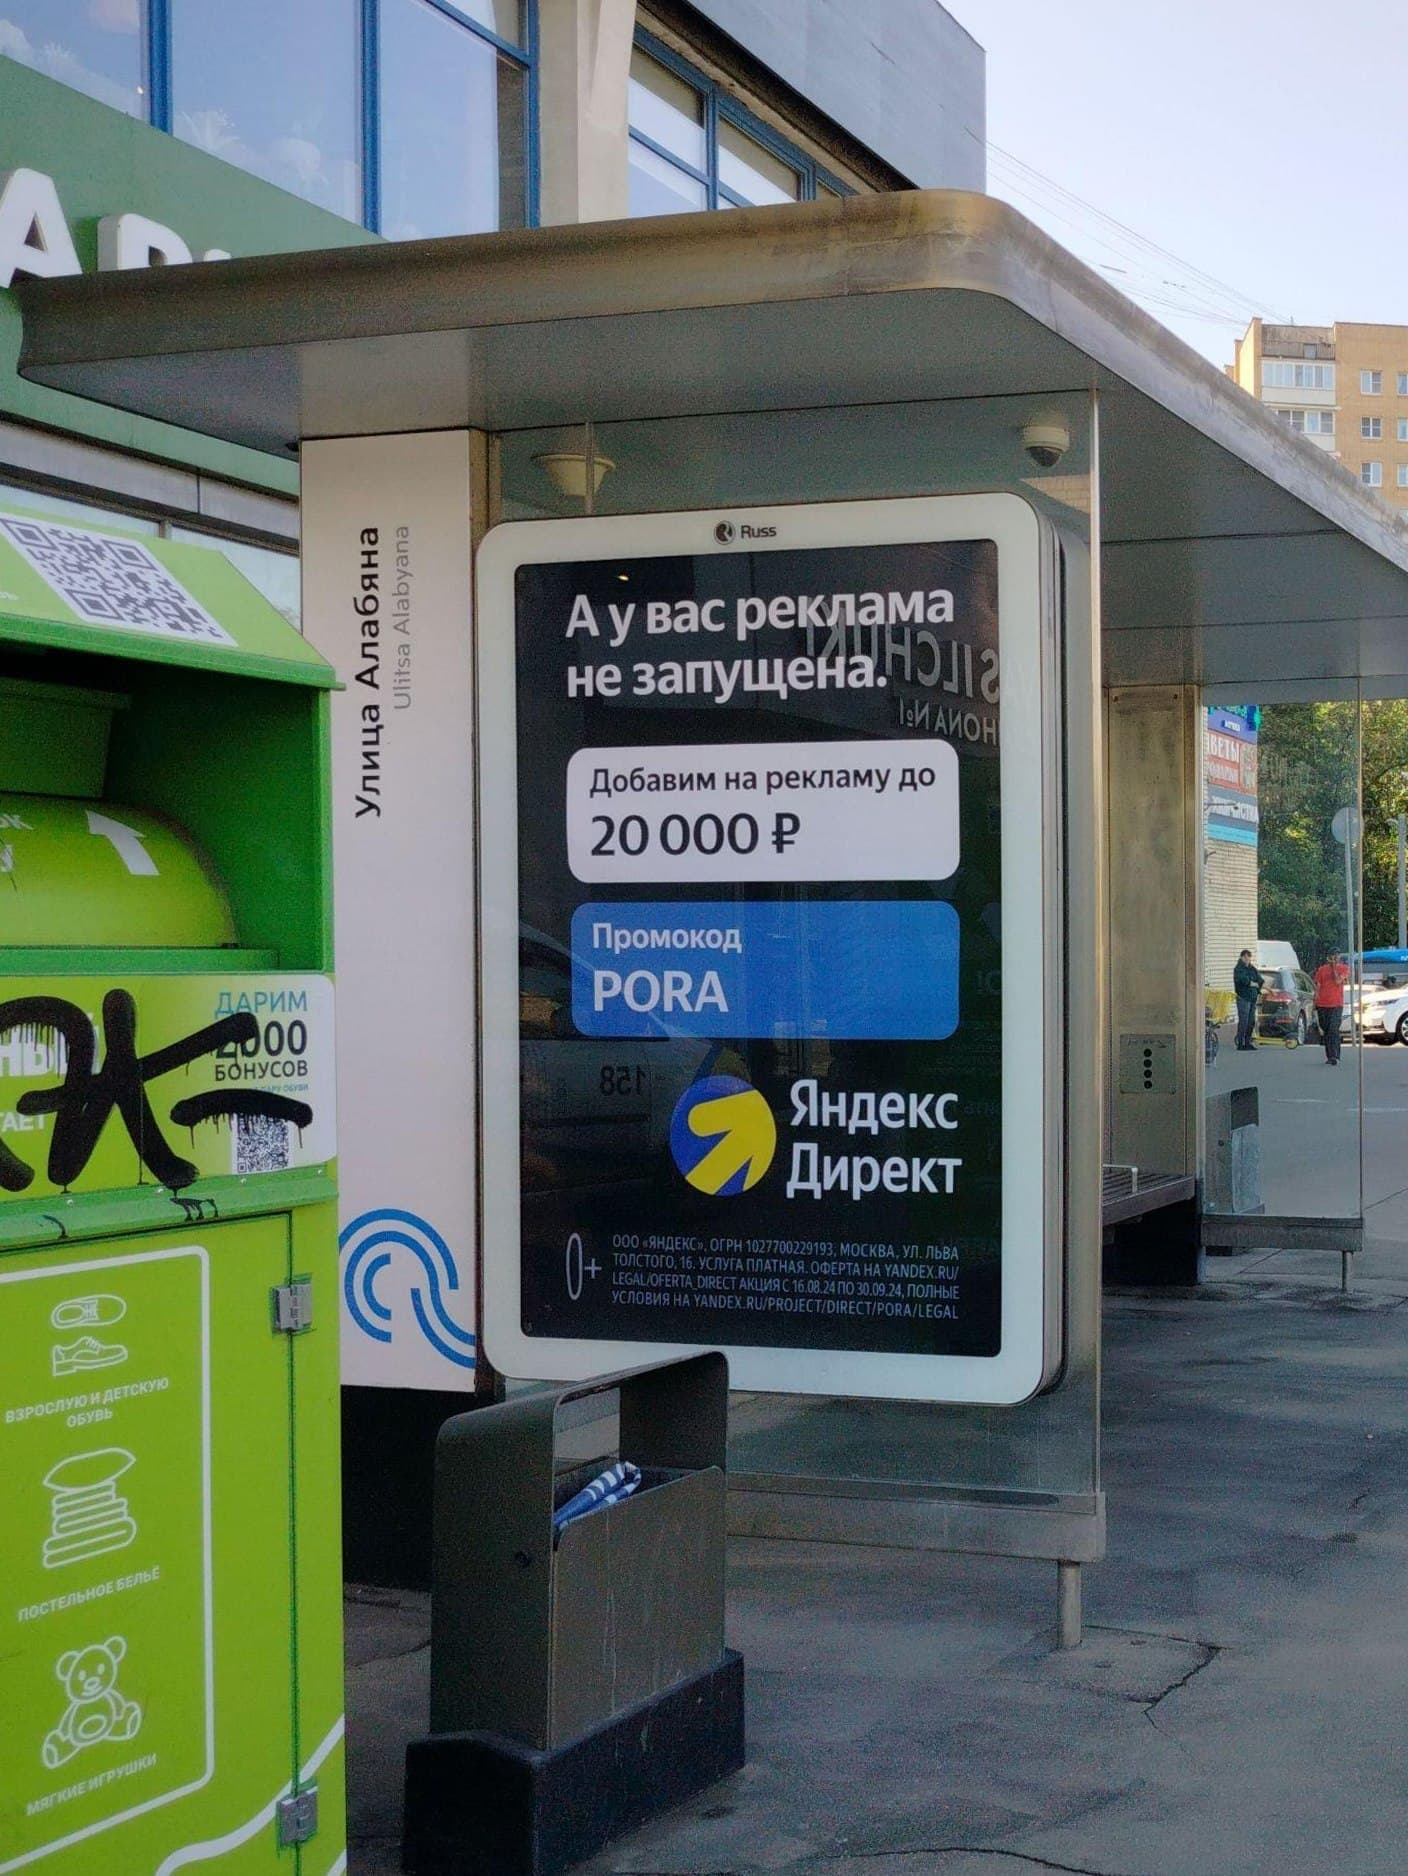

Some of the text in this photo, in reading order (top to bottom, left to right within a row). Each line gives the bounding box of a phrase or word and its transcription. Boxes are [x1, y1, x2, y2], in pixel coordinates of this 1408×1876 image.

[741, 524, 777, 539] Russ
[391, 525, 414, 710] Ulitsa Alabyana
[566, 588, 954, 647] А у вас реклама
[353, 527, 384, 818] Улица Алабяна
[567, 654, 887, 703] не запущена.
[1208, 734, 1240, 763] ВЕТЫ
[590, 766, 935, 797] Добавим на рекламу до
[592, 922, 743, 954] Промокод
[215, 990, 308, 1019] ДАРИМ
[593, 970, 729, 1012] PORA
[215, 1060, 308, 1082] БОНУСОВ
[0, 1112, 46, 1132] АЕТ
[790, 1079, 958, 1135] Яндекс
[786, 1142, 963, 1200] Директ
[612, 1234, 640, 1249] ООО
[710, 1238, 742, 1252] ОГРН
[840, 1243, 900, 1260] МОСКВА,
[903, 1245, 922, 1259] УЛ.
[925, 1245, 959, 1260] ЛЬВА
[613, 1252, 677, 1270] ТОЛСТОГО,
[699, 1256, 743, 1272] УСЛУГА
[746, 1258, 808, 1274] ПЛАТНАЯ.
[811, 1261, 861, 1277] ОФЕРТА
[864, 1263, 881, 1277] НА
[884, 1264, 960, 1280] YANDEX.RU/
[612, 1290, 670, 1305] УСЛОВИЯ
[673, 1292, 691, 1307] НА
[739, 1276, 780, 1293] АКЦИЯ
[838, 1281, 855, 1296] ПО
[907, 1284, 960, 1300] ПОЛНЫЕ
[5, 1377, 169, 1424] ВЗРОСЛУЮ И ДЕТСКУЮ
[66, 1407, 113, 1429] ОБУВЬ
[18, 1582, 114, 1623] ПОСТЕЛЬНОЕ
[26, 1752, 157, 1816] МЯГКИЕ ИГРУШКИ
